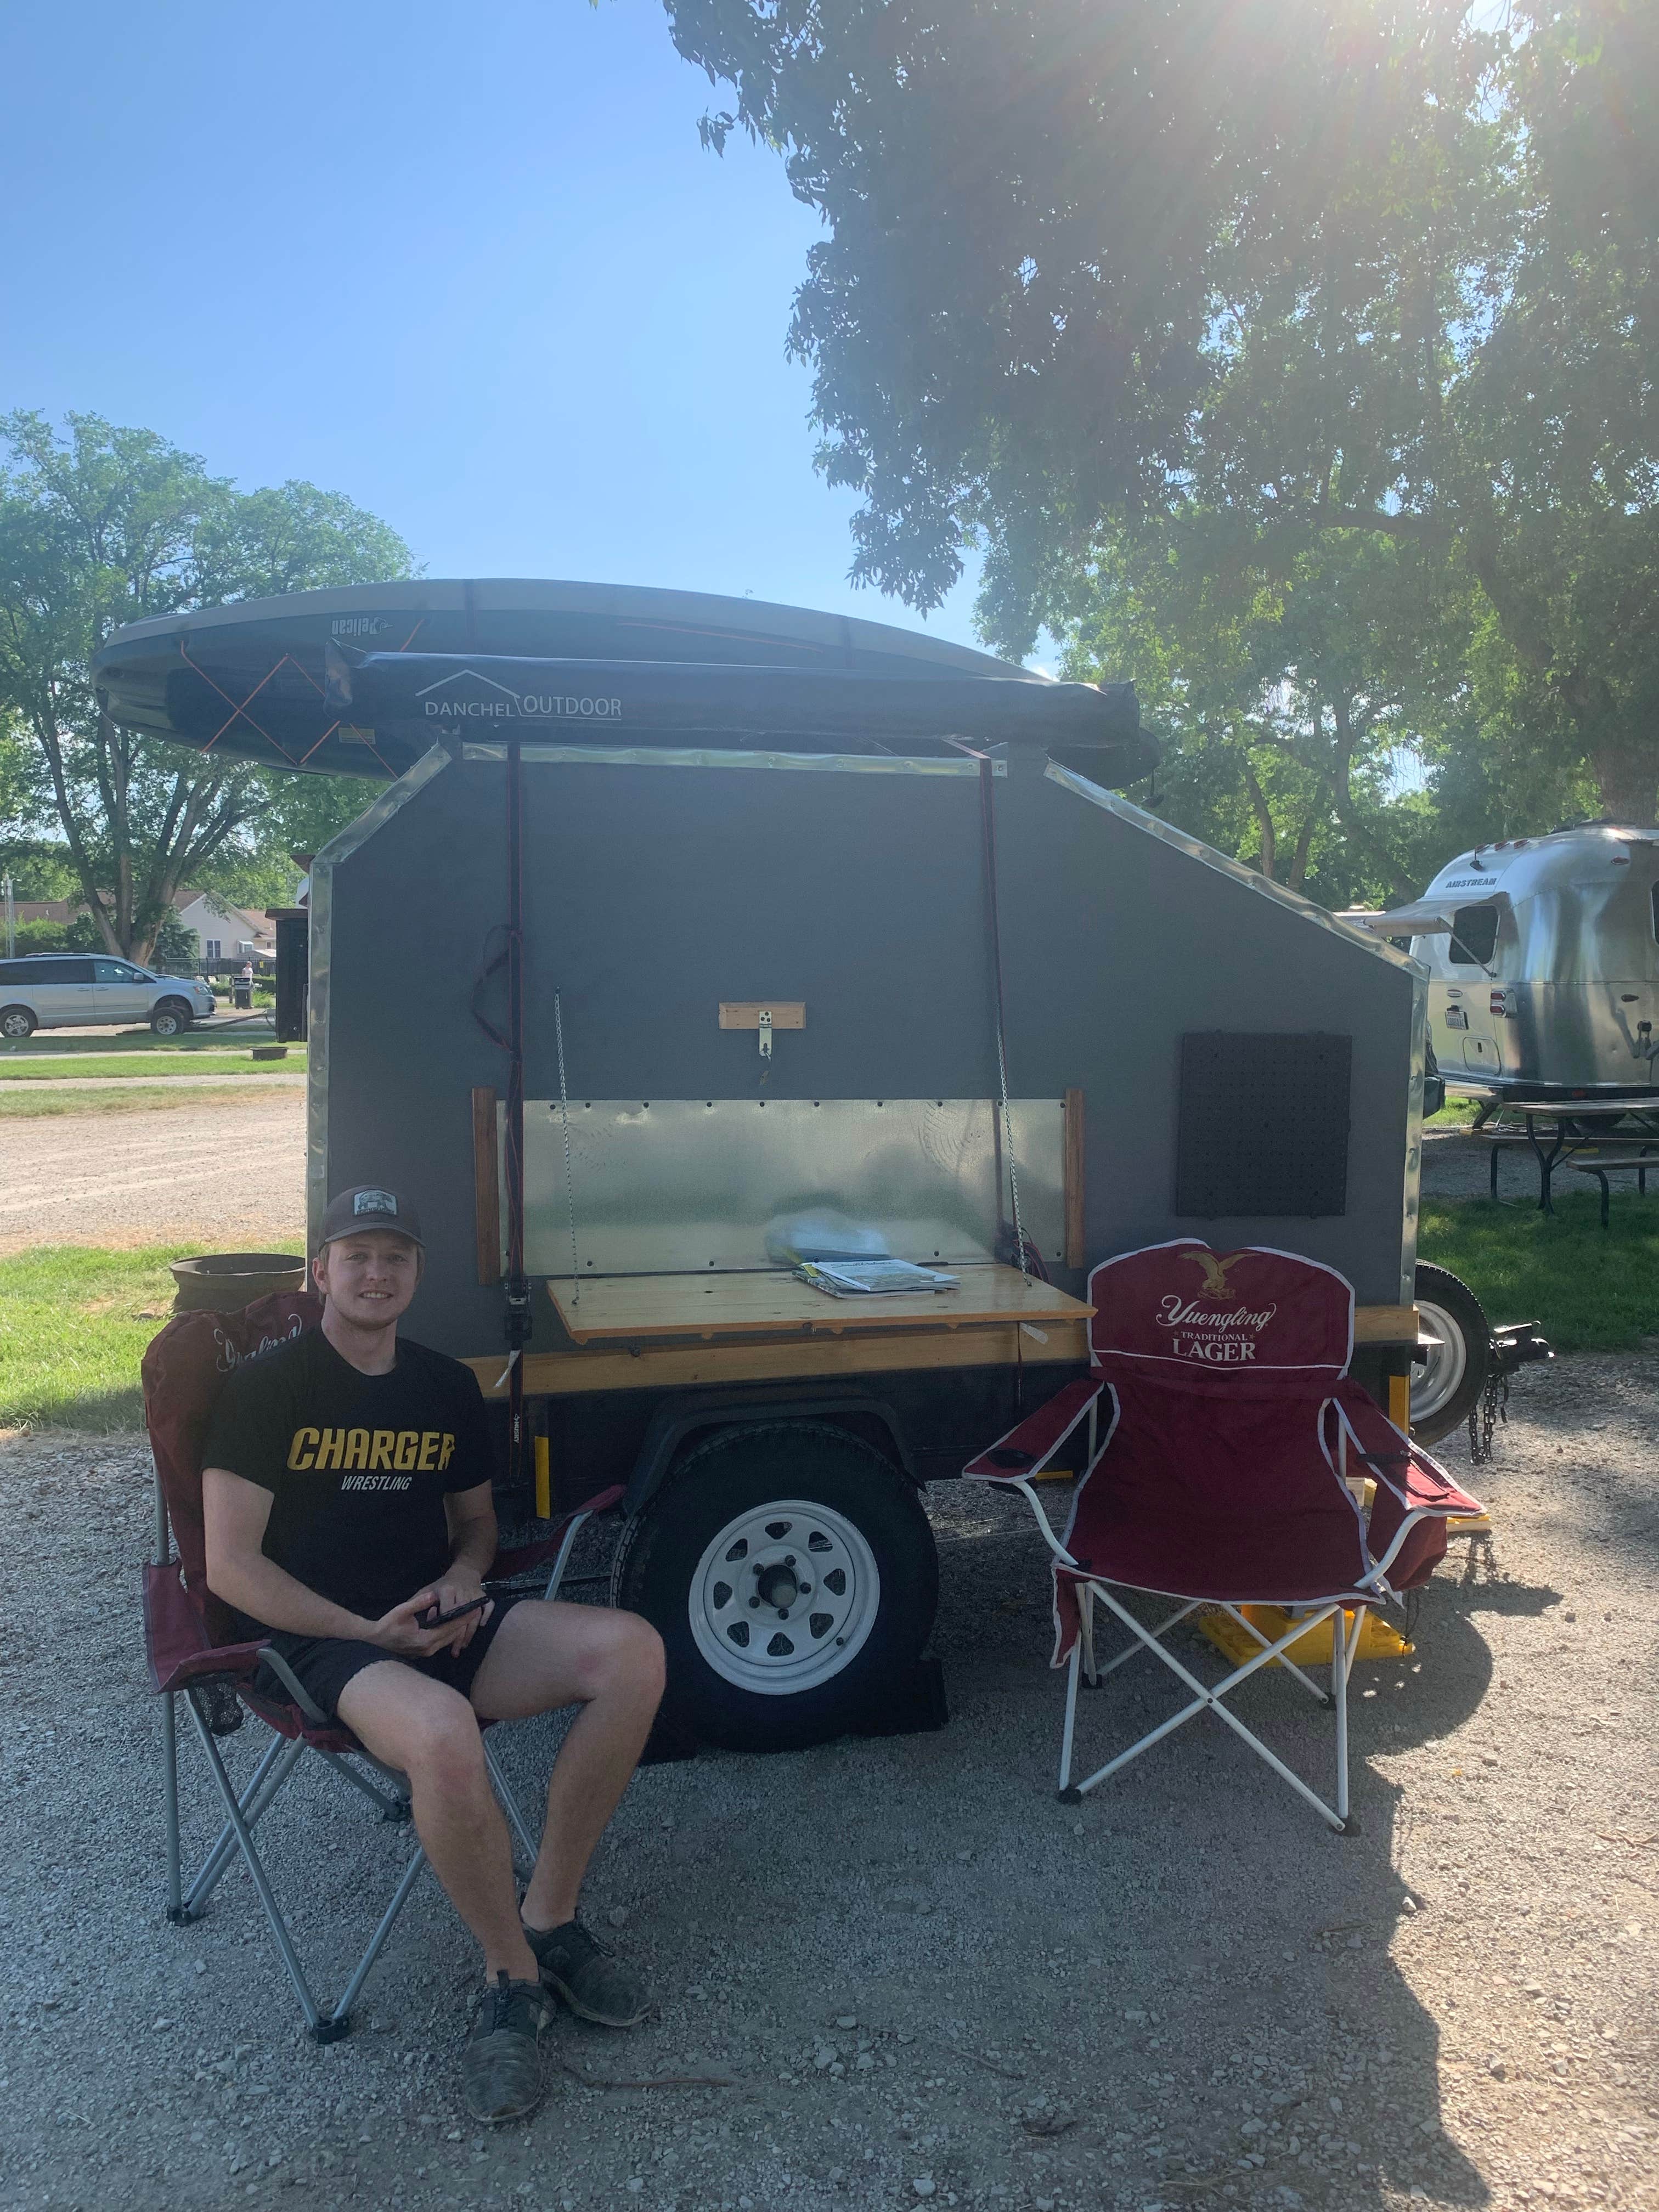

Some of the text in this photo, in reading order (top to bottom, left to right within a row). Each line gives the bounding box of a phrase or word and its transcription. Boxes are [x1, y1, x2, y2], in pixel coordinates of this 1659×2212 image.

[331, 617, 386, 636] Pelican
[425, 695, 622, 717] DANCHEL OUTDOOR
[1445, 877, 1497, 888] AIRSTREAM
[1155, 1295, 1277, 1333] Yuengling
[1180, 1331, 1248, 1342] TRADITIONAL
[1172, 1338, 1256, 1362] LAGER
[341, 1475, 412, 1490] WRESTLING
